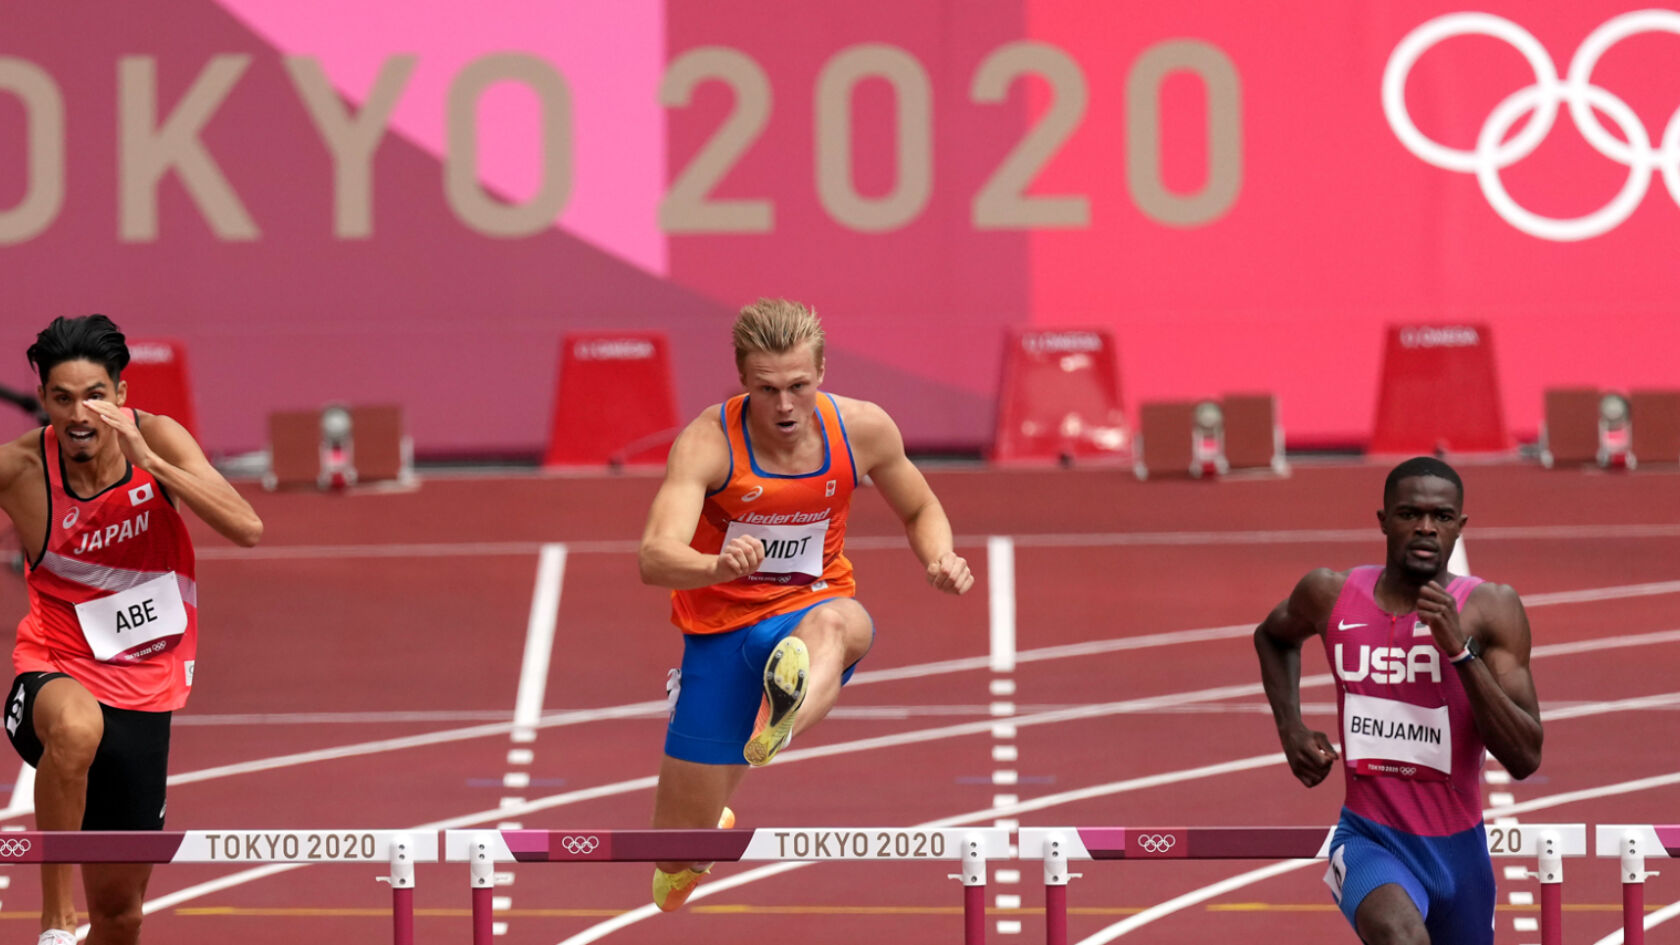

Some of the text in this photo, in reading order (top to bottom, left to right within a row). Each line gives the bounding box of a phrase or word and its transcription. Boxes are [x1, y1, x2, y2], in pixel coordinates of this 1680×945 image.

[656, 38, 1243, 234] 2020
[74, 511, 149, 555] JAPAN
[116, 599, 157, 633] ABE
[1334, 643, 1441, 684] USA
[1351, 716, 1441, 745] BENJAMIN
[1368, 763, 1385, 772] TOKYO
[205, 833, 375, 859] TOKYO 2020
[774, 832, 945, 857] TOKYO 2020
